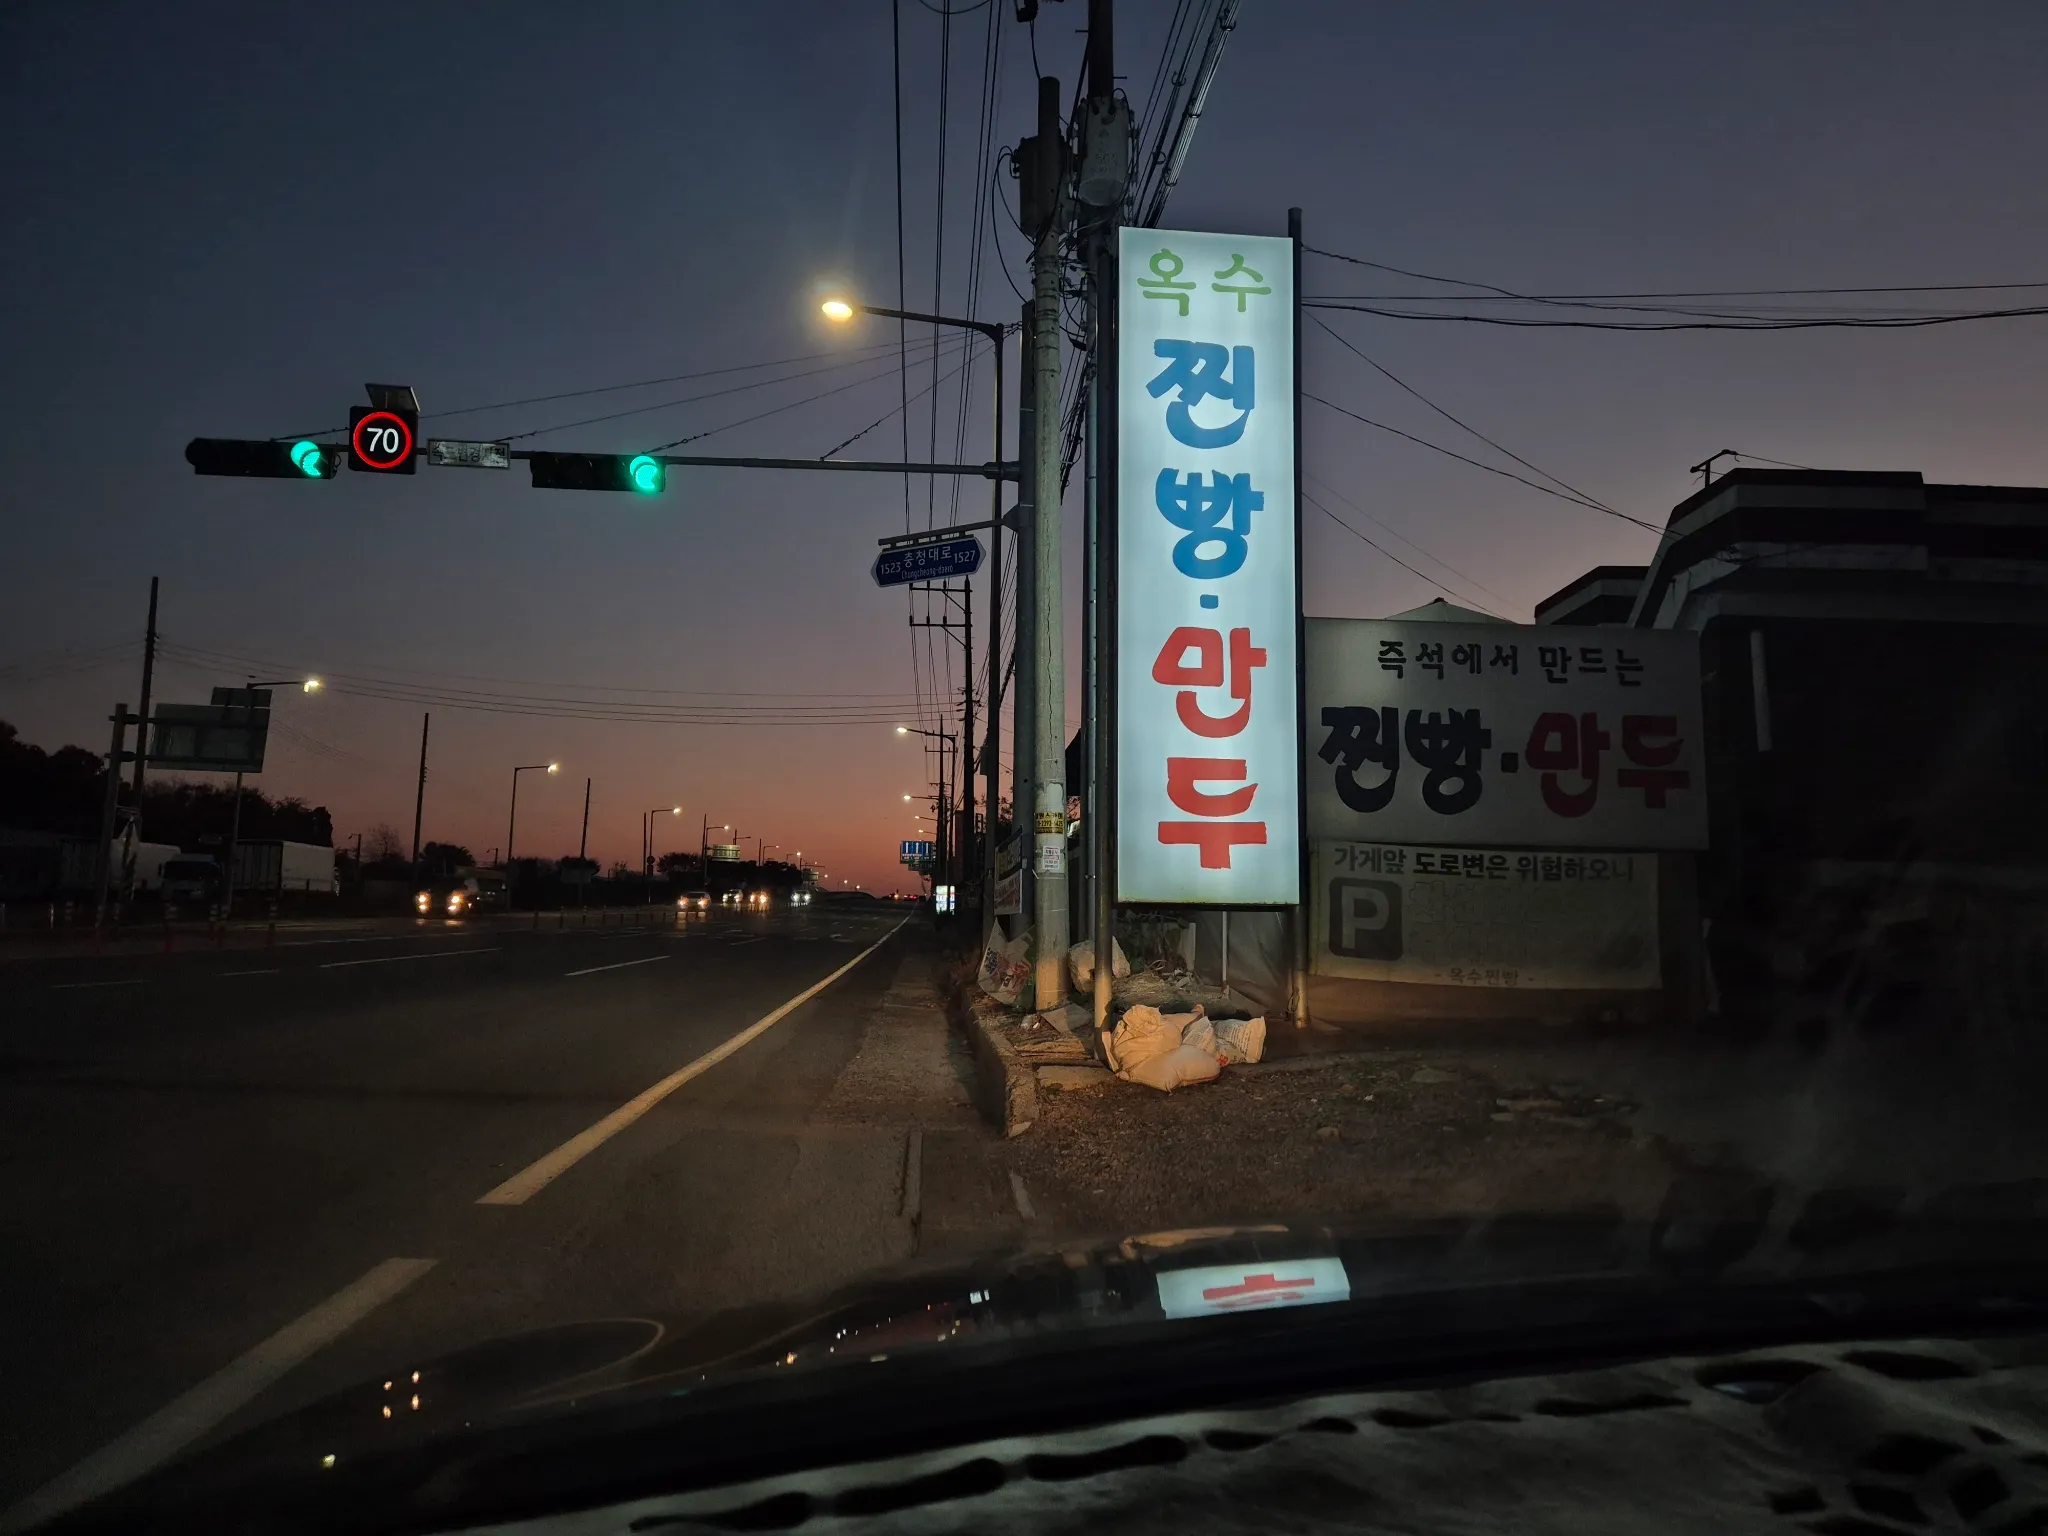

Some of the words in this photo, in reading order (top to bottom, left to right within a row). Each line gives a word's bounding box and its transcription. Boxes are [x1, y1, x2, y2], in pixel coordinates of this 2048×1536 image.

[1136, 248, 1272, 317] 옥수
[366, 427, 399, 454] 70
[880, 562, 901, 575] 1523
[903, 545, 952, 568] 충청대로
[953, 549, 976, 564] 1527
[901, 564, 954, 580] Chungcheong-daero
[1378, 640, 1519, 680] 즉석에서
[1538, 646, 1644, 687] 만드는
[1334, 846, 1407, 875] 가게앞
[1413, 851, 1510, 880] 도로변은
[1516, 855, 1634, 882] 위험하오니
[1341, 885, 1390, 950] P
[1449, 966, 1519, 986] 옥수찐빵
